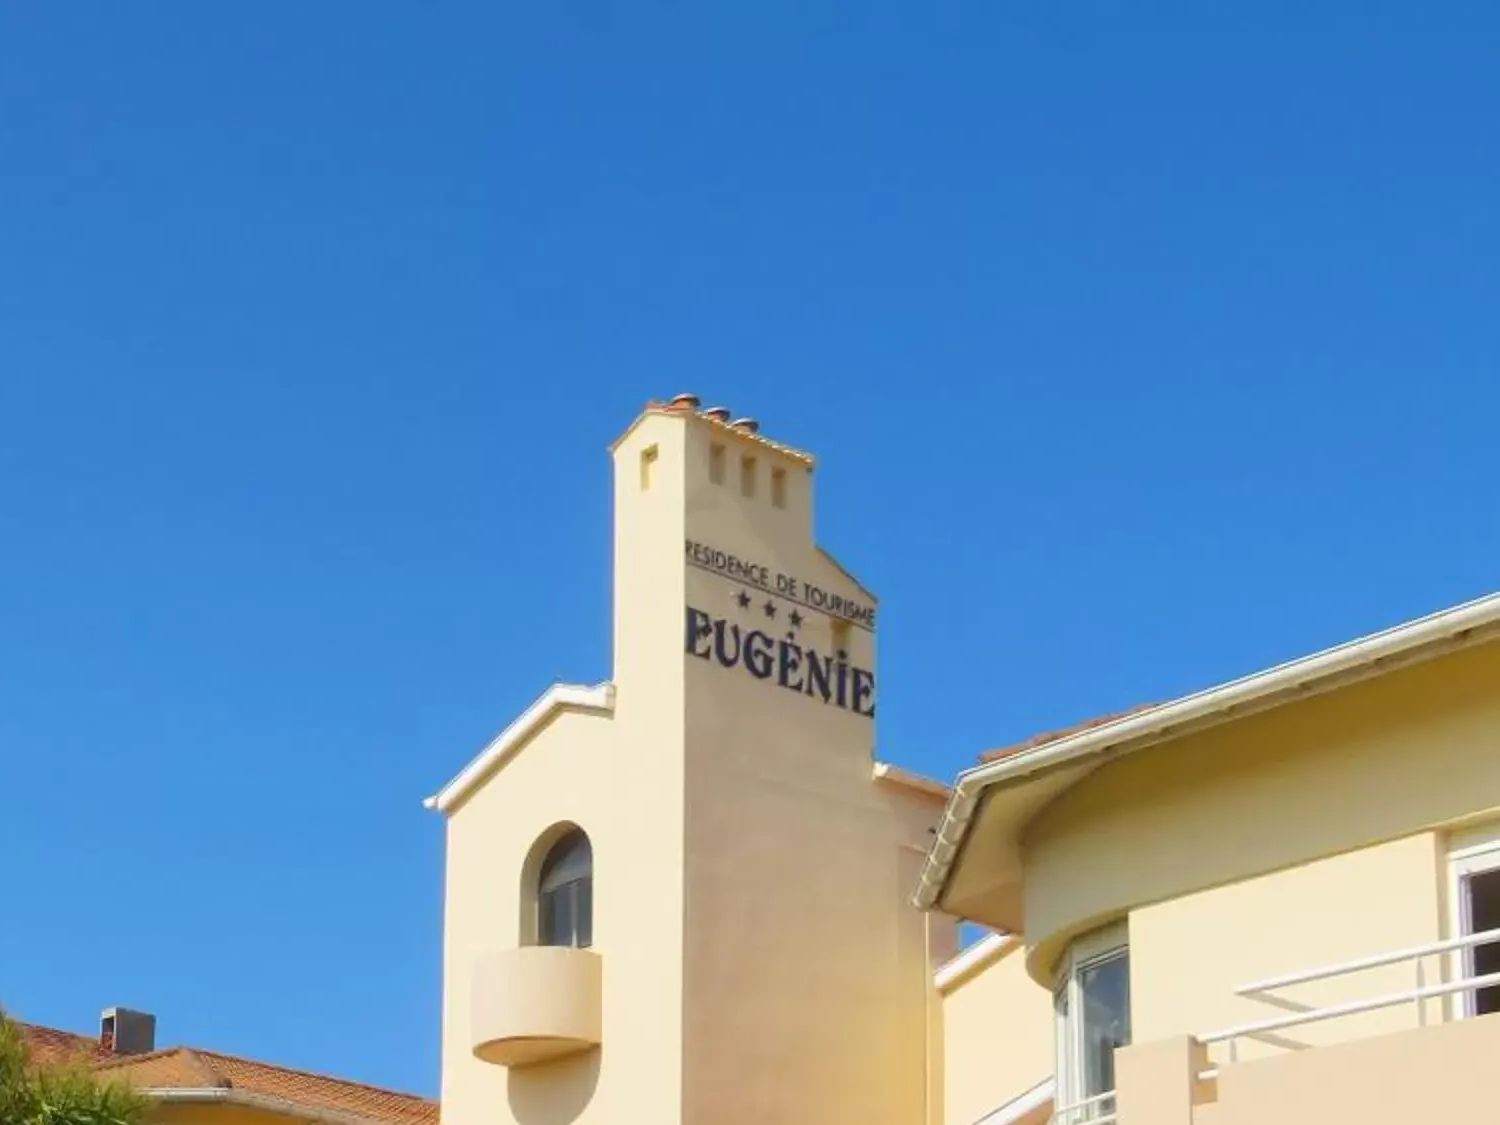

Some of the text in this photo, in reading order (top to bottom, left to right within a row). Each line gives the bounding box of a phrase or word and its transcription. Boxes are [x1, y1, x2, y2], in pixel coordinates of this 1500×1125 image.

[685, 539, 876, 627] RESIDENCE DE TOURISME
